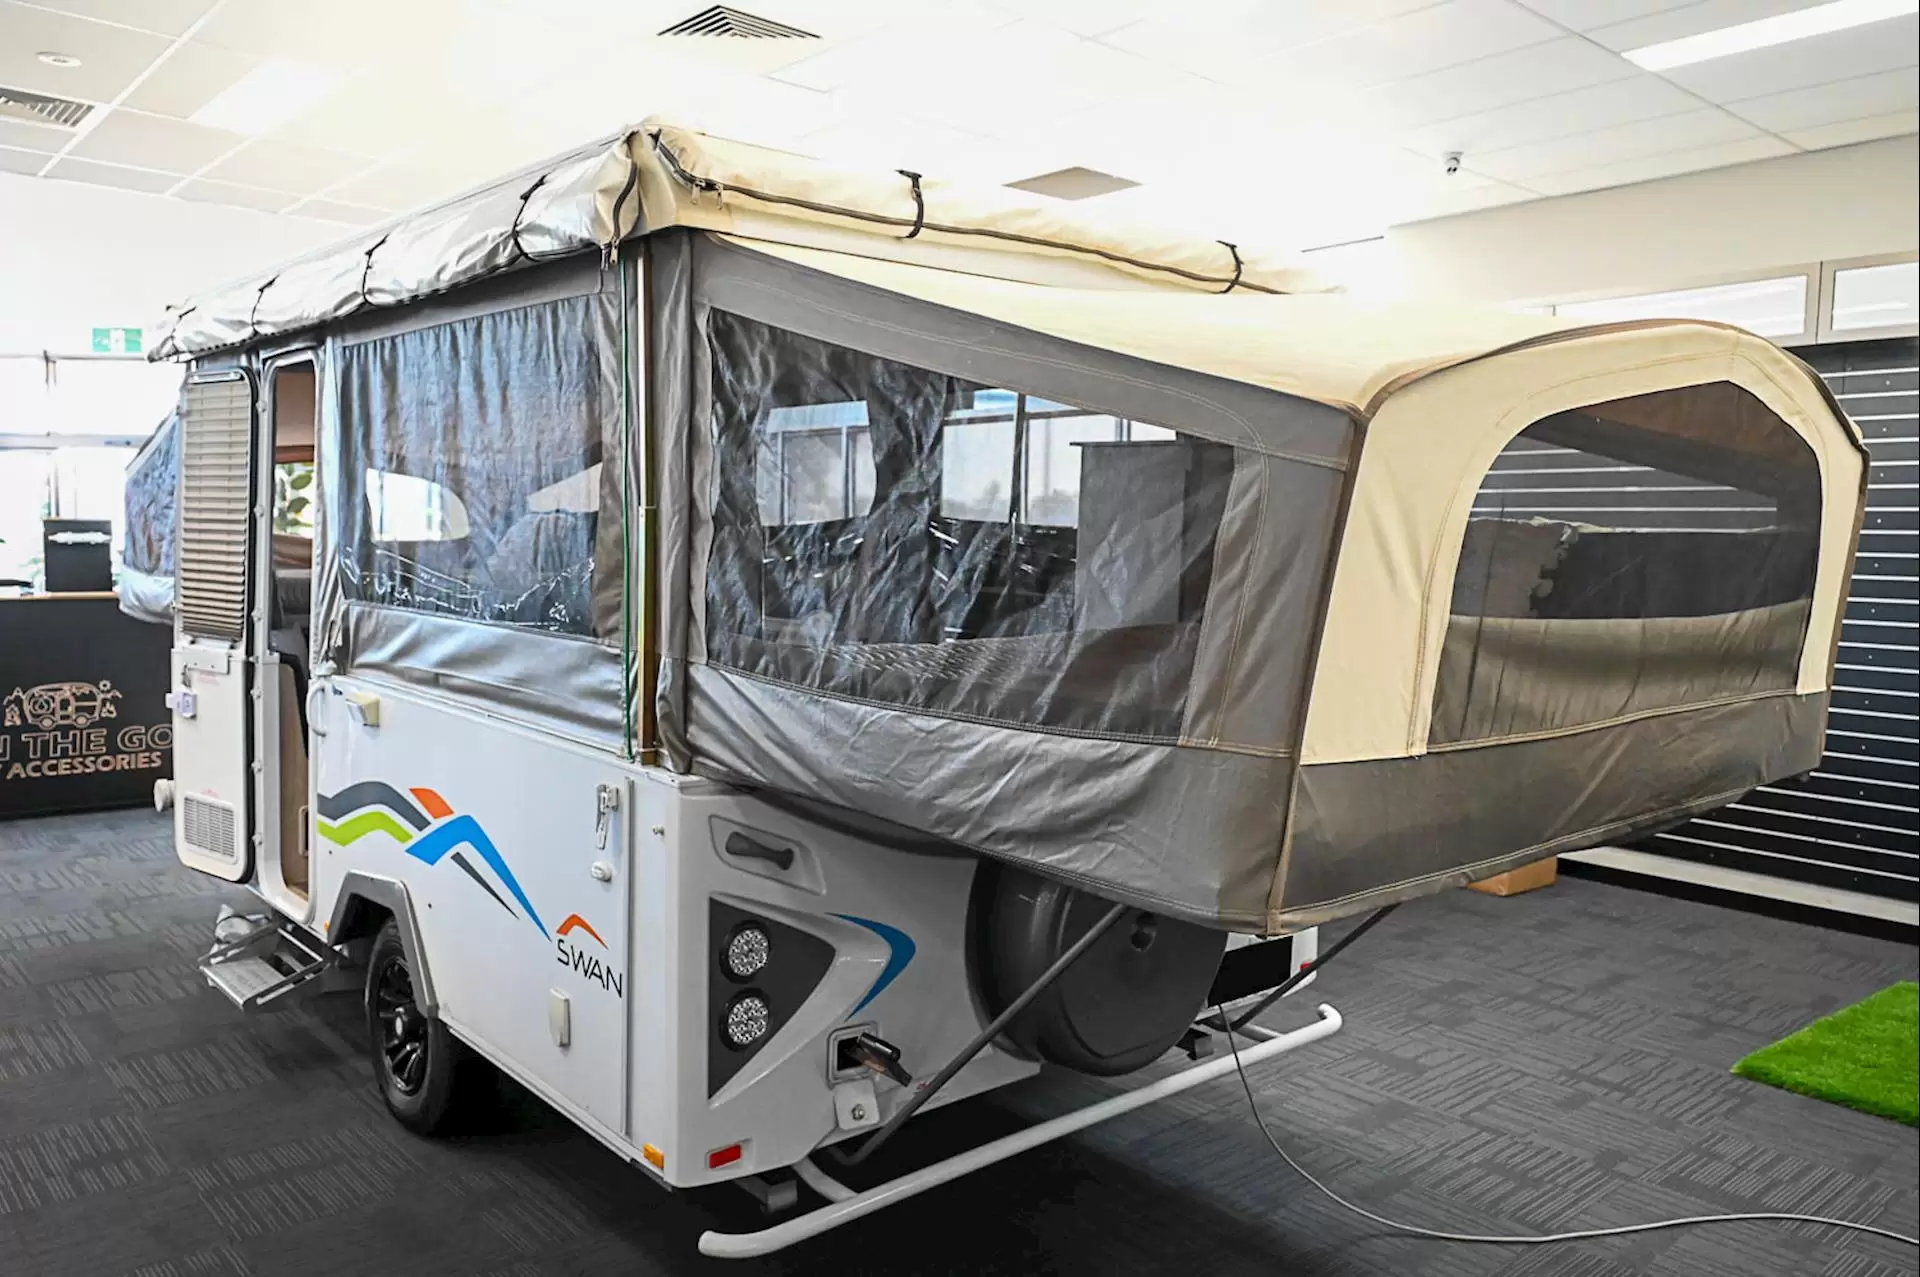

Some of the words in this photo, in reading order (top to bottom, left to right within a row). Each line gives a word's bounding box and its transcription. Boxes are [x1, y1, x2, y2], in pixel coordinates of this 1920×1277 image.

[21, 728, 107, 759] THE
[117, 724, 173, 751] GO
[6, 751, 162, 779] ACCESSORIES
[557, 938, 622, 998] SWAN
